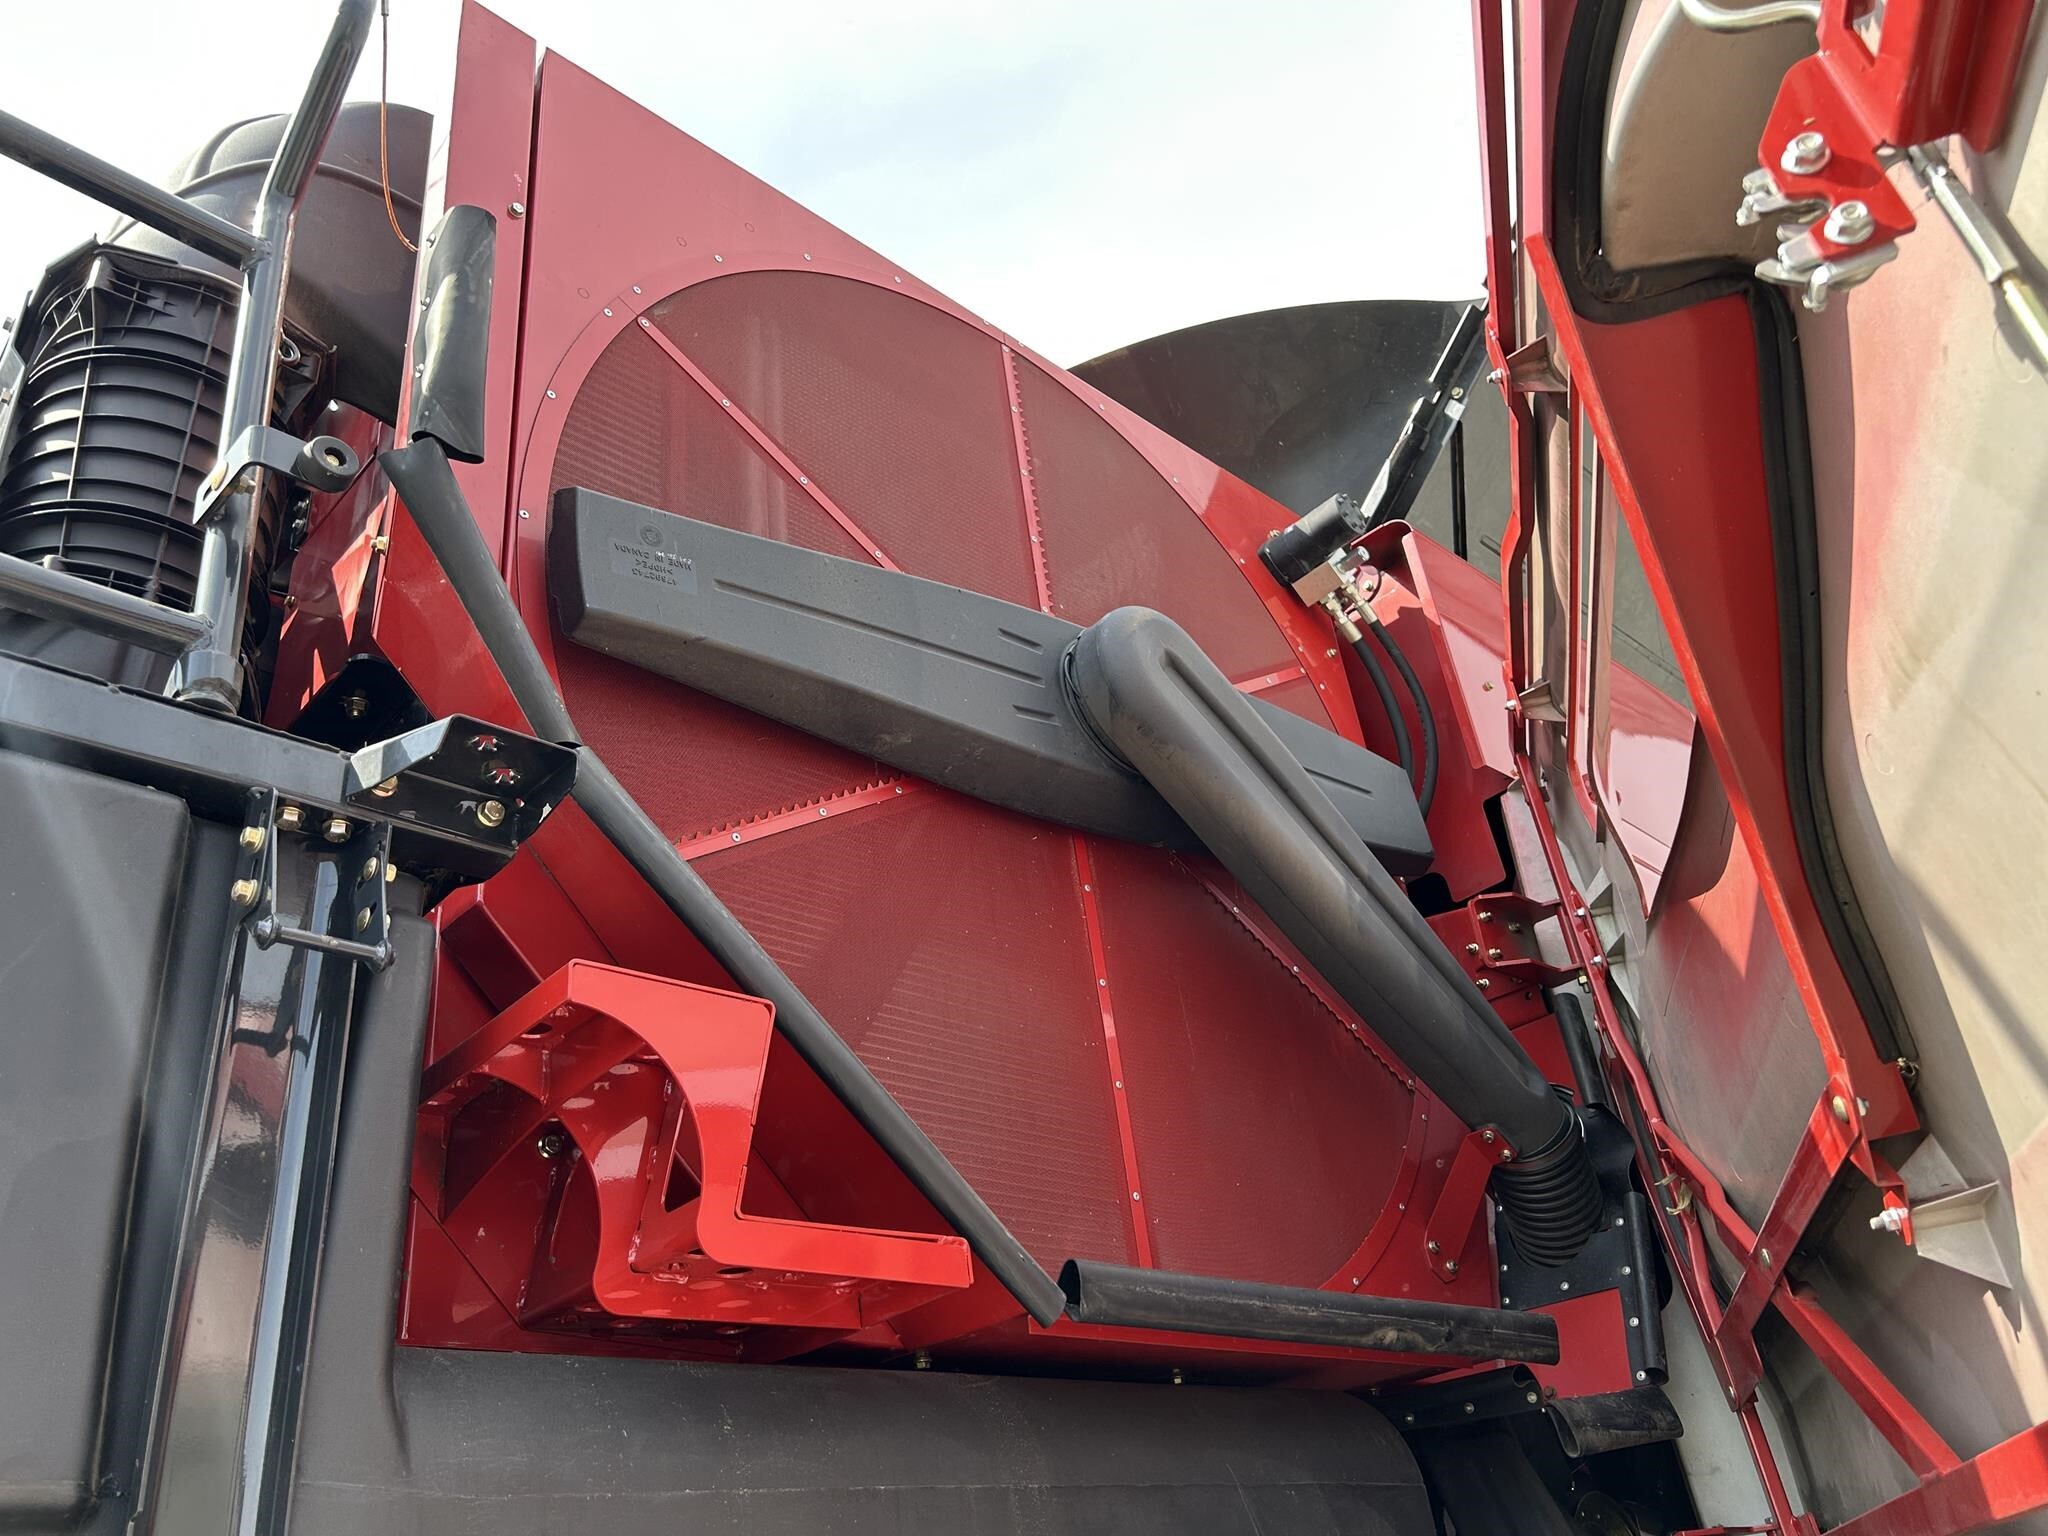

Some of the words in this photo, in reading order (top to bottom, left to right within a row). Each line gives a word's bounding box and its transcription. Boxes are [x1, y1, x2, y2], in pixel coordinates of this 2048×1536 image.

[614, 543, 650, 560] CANADA
[654, 553, 664, 564] IN
[667, 558, 692, 571] MADE
